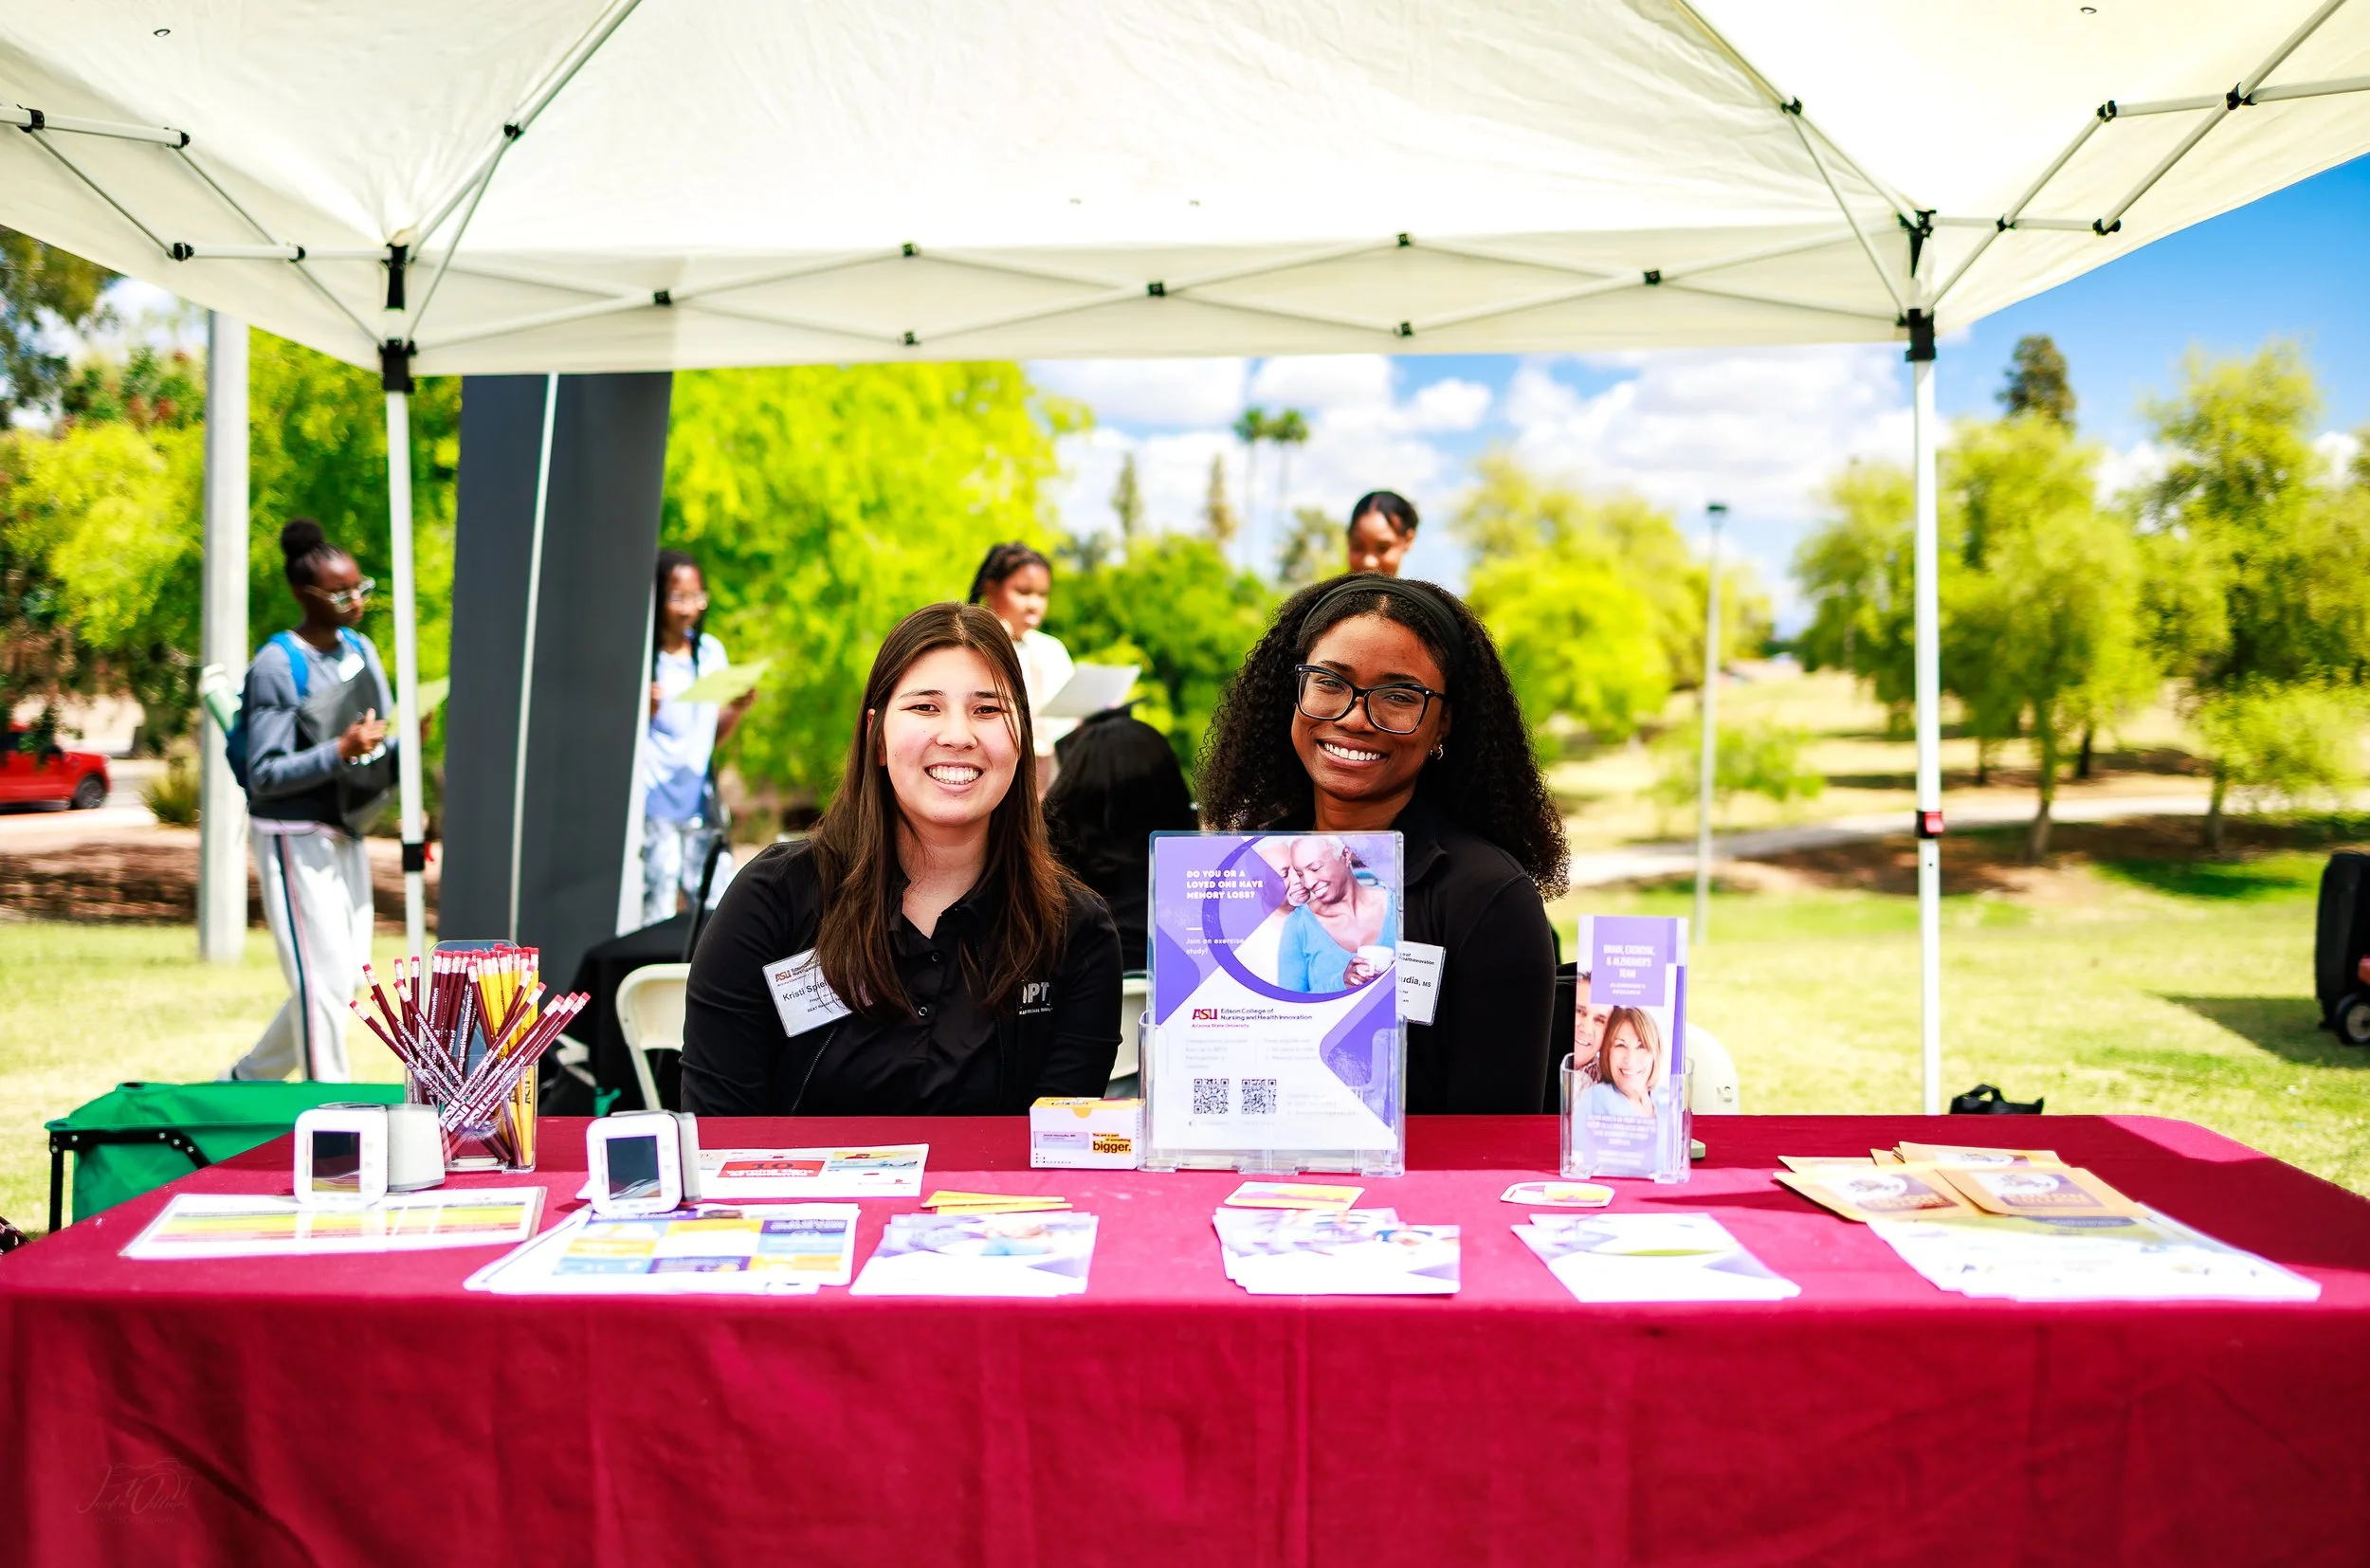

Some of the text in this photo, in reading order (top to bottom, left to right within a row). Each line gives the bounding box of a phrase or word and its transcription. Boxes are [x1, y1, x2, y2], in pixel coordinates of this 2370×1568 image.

[1239, 880, 1264, 888] HAVE
[1186, 891, 1255, 900] MEMORY LOSS?
[775, 970, 792, 982] ASU
[1619, 969, 1636, 978] TEAM
[782, 989, 805, 1002] Kristi
[1192, 1008, 1217, 1020] ASU
[413, 1012, 440, 1047] Innovation
[436, 1098, 461, 1127] ASU
[445, 1103, 470, 1132] ASU
[1093, 1140, 1131, 1154] bigger.
